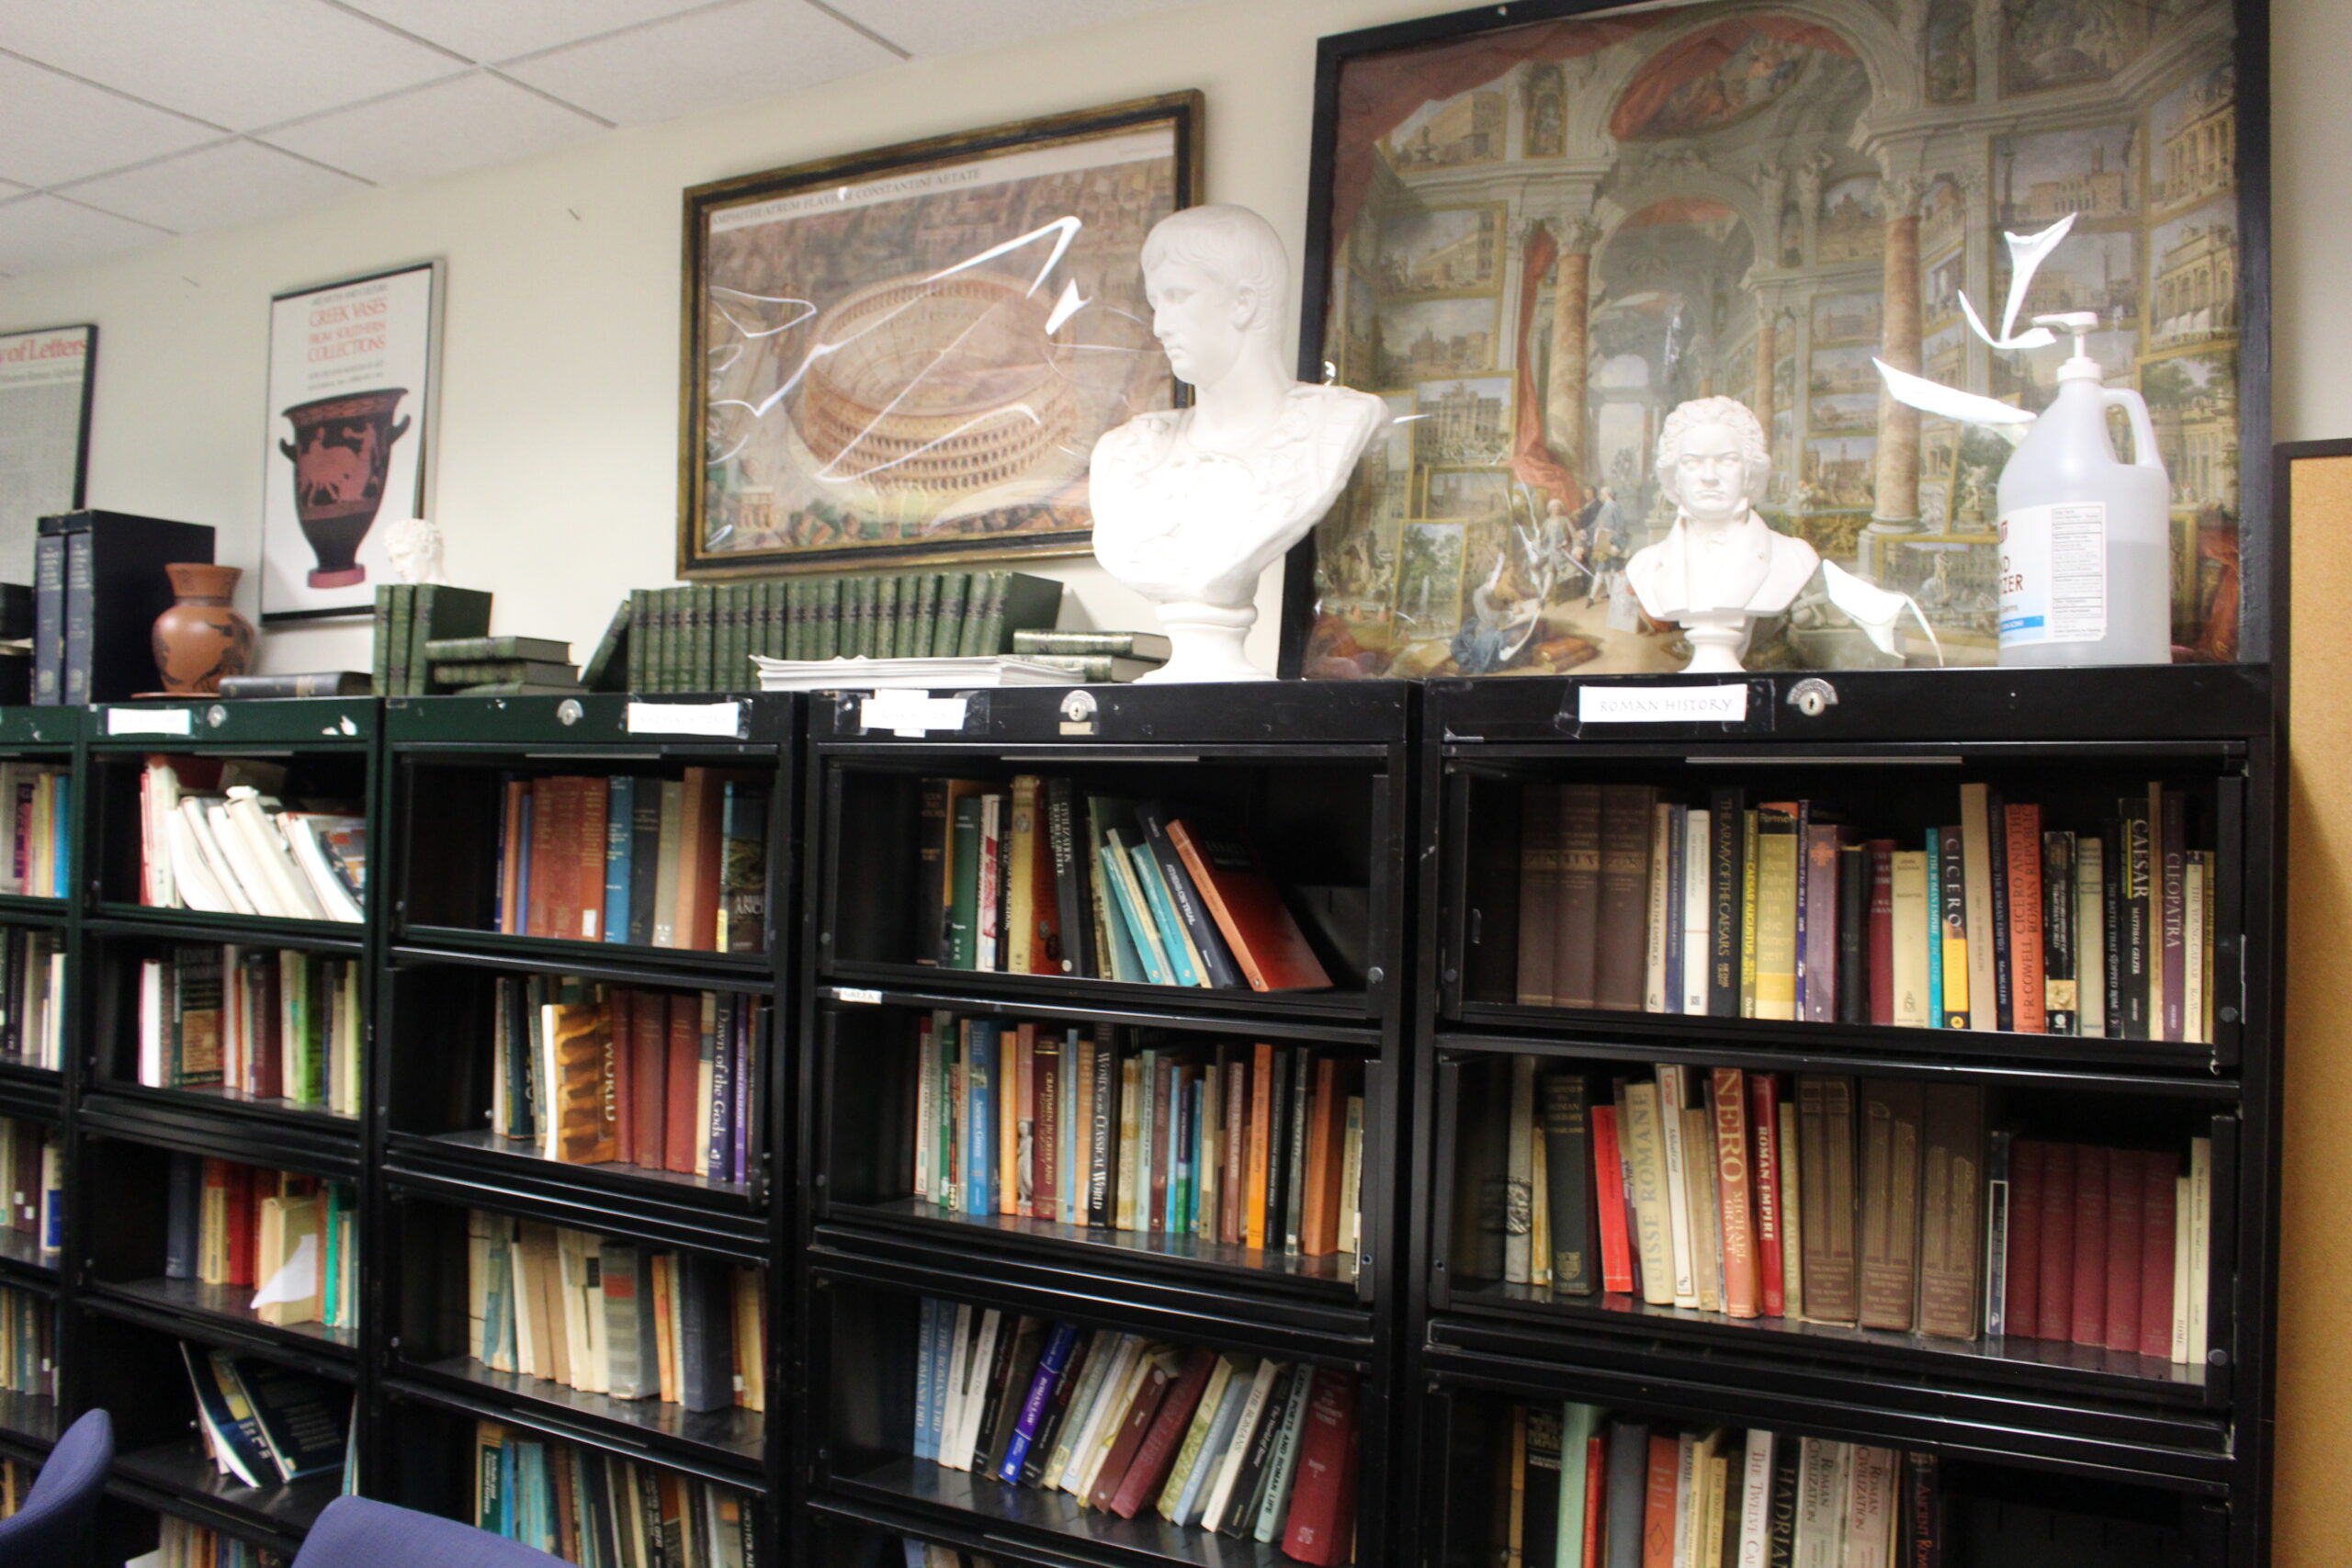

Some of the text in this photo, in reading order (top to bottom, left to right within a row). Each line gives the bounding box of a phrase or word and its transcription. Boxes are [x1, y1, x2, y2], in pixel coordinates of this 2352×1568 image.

[712, 201, 800, 226] AMPHITHEATRUM
[804, 191, 853, 210] FLAVIM
[309, 298, 388, 328] GREEK VASES
[28, 338, 86, 360] Letters
[308, 334, 386, 363] COLLECTIONS
[1600, 698, 1735, 713] ROMAN HISTORY
[1945, 838, 1962, 928] CICERO
[2009, 808, 2025, 934] CICERO AND THE
[2132, 819, 2149, 899] CAESAR
[1745, 862, 1756, 954] CAESAR AUGUSTUS
[2026, 880, 2039, 933] ROMAN
[2109, 883, 2117, 898] THE
[2109, 900, 2118, 929] BATTLE
[2165, 852, 2181, 948] CLEOPATRA
[1717, 902, 1732, 956] CAESARS
[2109, 931, 2118, 953] THAT
[2132, 907, 2141, 975] MATTHIAS GELZER
[2189, 886, 2199, 979] THE YOUNG CAESAR
[711, 1007, 730, 1139] Dawn of the Gods
[1044, 1072, 1054, 1122] CRAFTSMEN
[1096, 1052, 1110, 1093] WOMEN
[1665, 1074, 1675, 1106] Caesar
[1093, 1114, 1109, 1169] CLASSICAL
[1715, 1069, 1744, 1182] NERO
[1045, 1164, 1055, 1185] AND
[1091, 1169, 1106, 1211] WORLD
[1758, 1125, 1774, 1241] ROMAN EMPIRE
[1724, 1199, 1736, 1255] GRANT
[1733, 1190, 1747, 1265] MICHAEL
[1786, 1224, 1798, 1289] AUGUSTUS
[2176, 1318, 2184, 1345] ROME
[917, 1350, 929, 1403] ROMANS
[933, 1354, 947, 1407] ROMANS
[1024, 1376, 1048, 1425] ROMAN LAW
[916, 1404, 926, 1428] DID
[932, 1409, 943, 1433] DID
[1233, 1388, 1263, 1453] THE ROMANS
[1261, 1417, 1276, 1440] World
[1270, 1404, 1281, 1416] The
[1263, 1368, 1307, 1516] LATIN POETS AND ROMAN LIFE
[1683, 1446, 1693, 1484] ROME
[1747, 1449, 1767, 1535] THE TWELVE
[1806, 1438, 1821, 1525] CIVILIZATION
[1820, 1458, 1834, 1509] ROMAN
[1855, 1445, 1871, 1531] CIVILIZATION
[1869, 1464, 1883, 1516] ROMAN
[1917, 1483, 1931, 1538] ANCIENT
